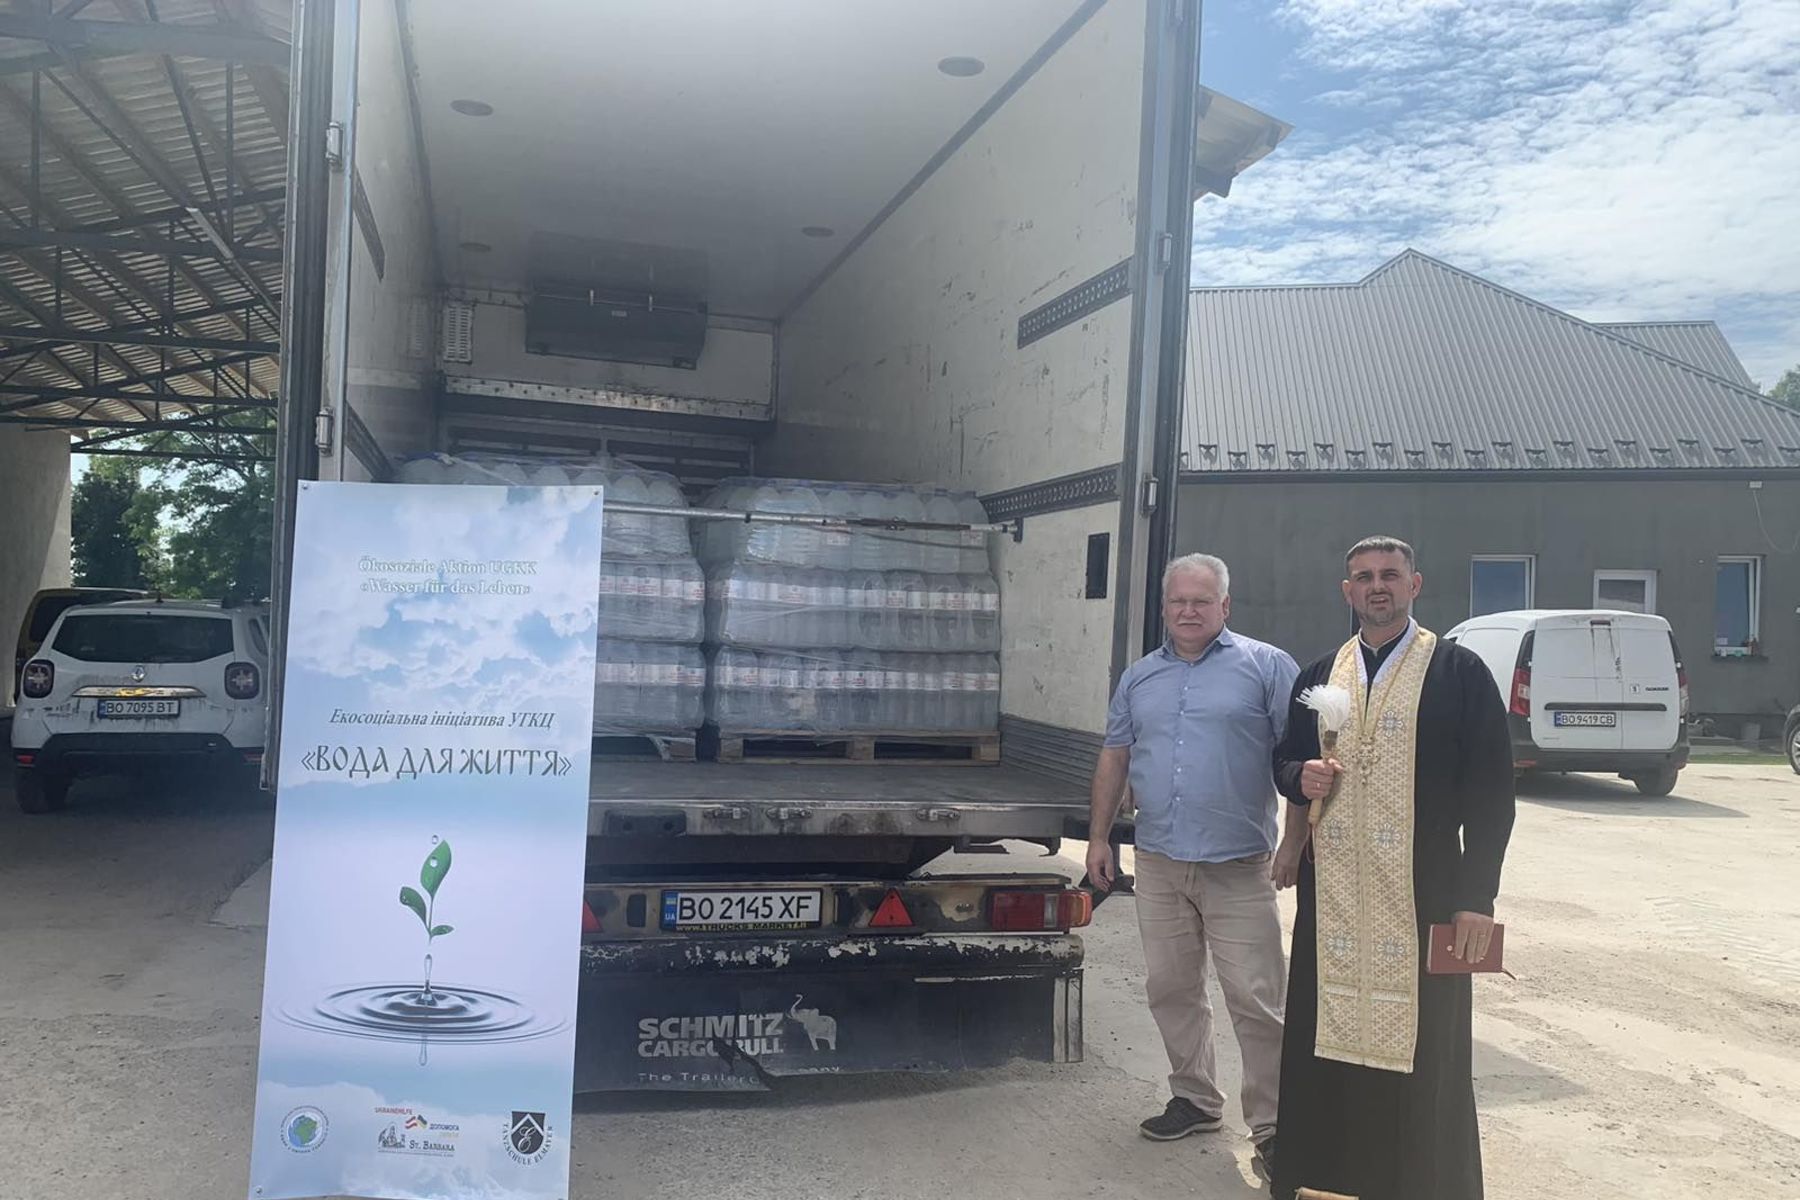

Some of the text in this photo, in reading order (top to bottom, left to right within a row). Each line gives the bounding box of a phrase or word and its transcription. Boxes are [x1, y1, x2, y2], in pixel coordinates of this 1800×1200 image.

[359, 555, 538, 575] Ökosoziale Aktion UGKK
[423, 578, 450, 593] für
[451, 579, 476, 594] das
[329, 708, 556, 730] Екосоціальна ініціатива УГКЦ
[396, 747, 453, 780] ДЛЯ
[665, 913, 676, 921] UA
[719, 896, 773, 920] 2145
[778, 896, 812, 919] XF
[638, 1013, 784, 1039] SCHMITZ
[638, 1072, 672, 1081] The
